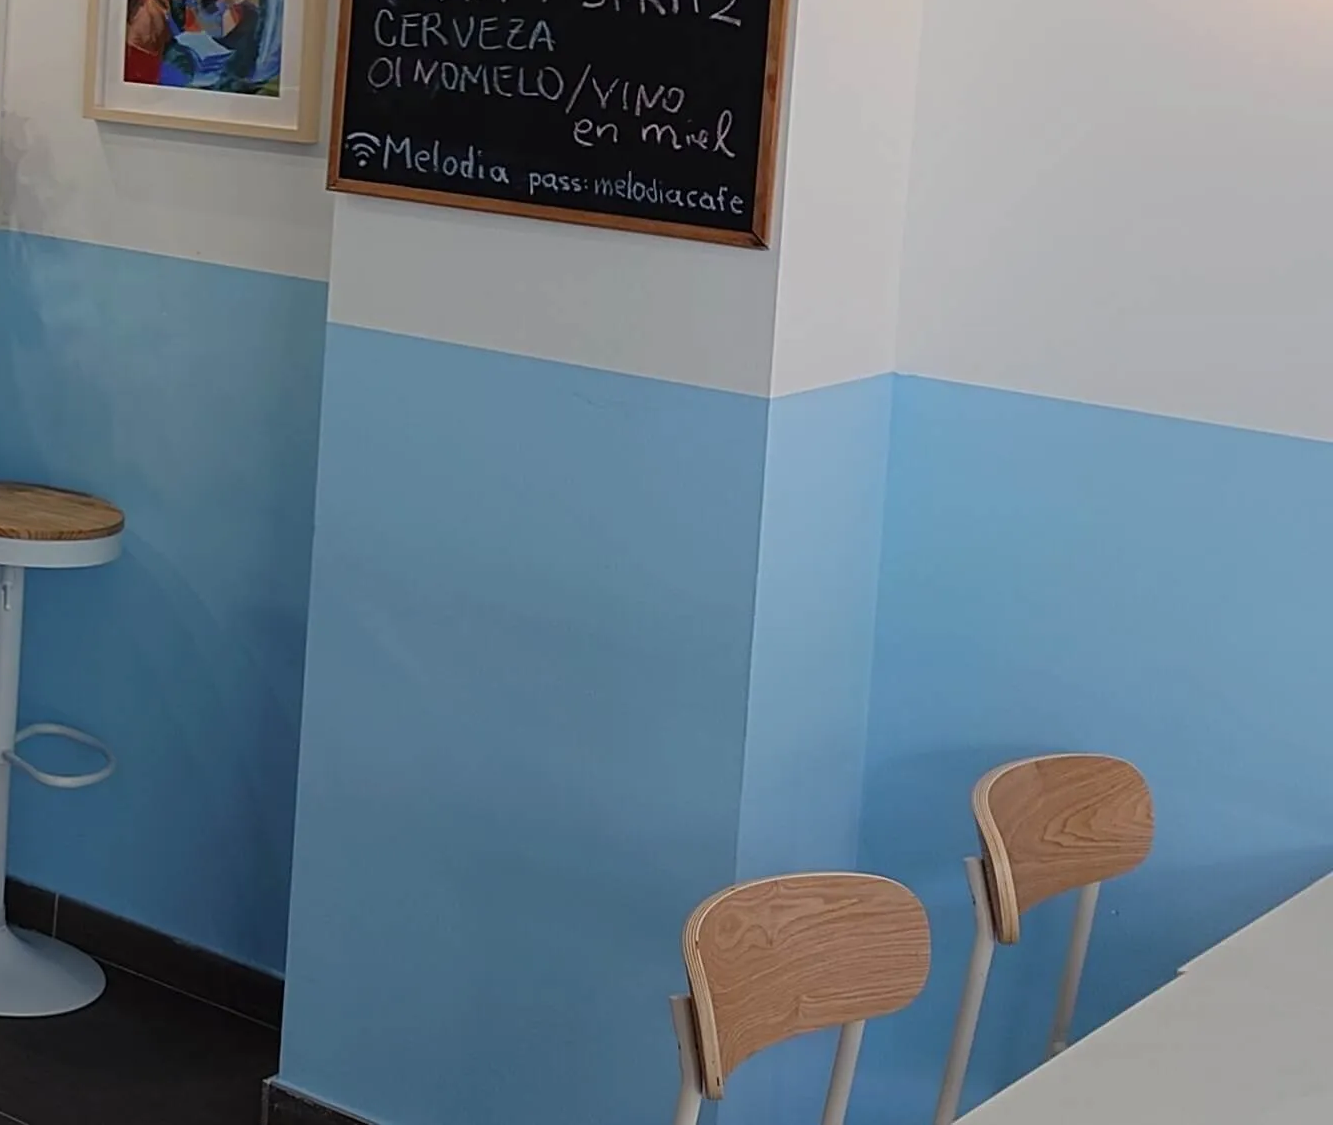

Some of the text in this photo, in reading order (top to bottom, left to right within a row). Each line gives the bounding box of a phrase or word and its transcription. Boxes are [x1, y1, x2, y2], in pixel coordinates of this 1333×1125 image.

[374, 9, 556, 52] CERVEZA
[573, 110, 736, 158] en miel
[383, 134, 510, 185] Melodia
